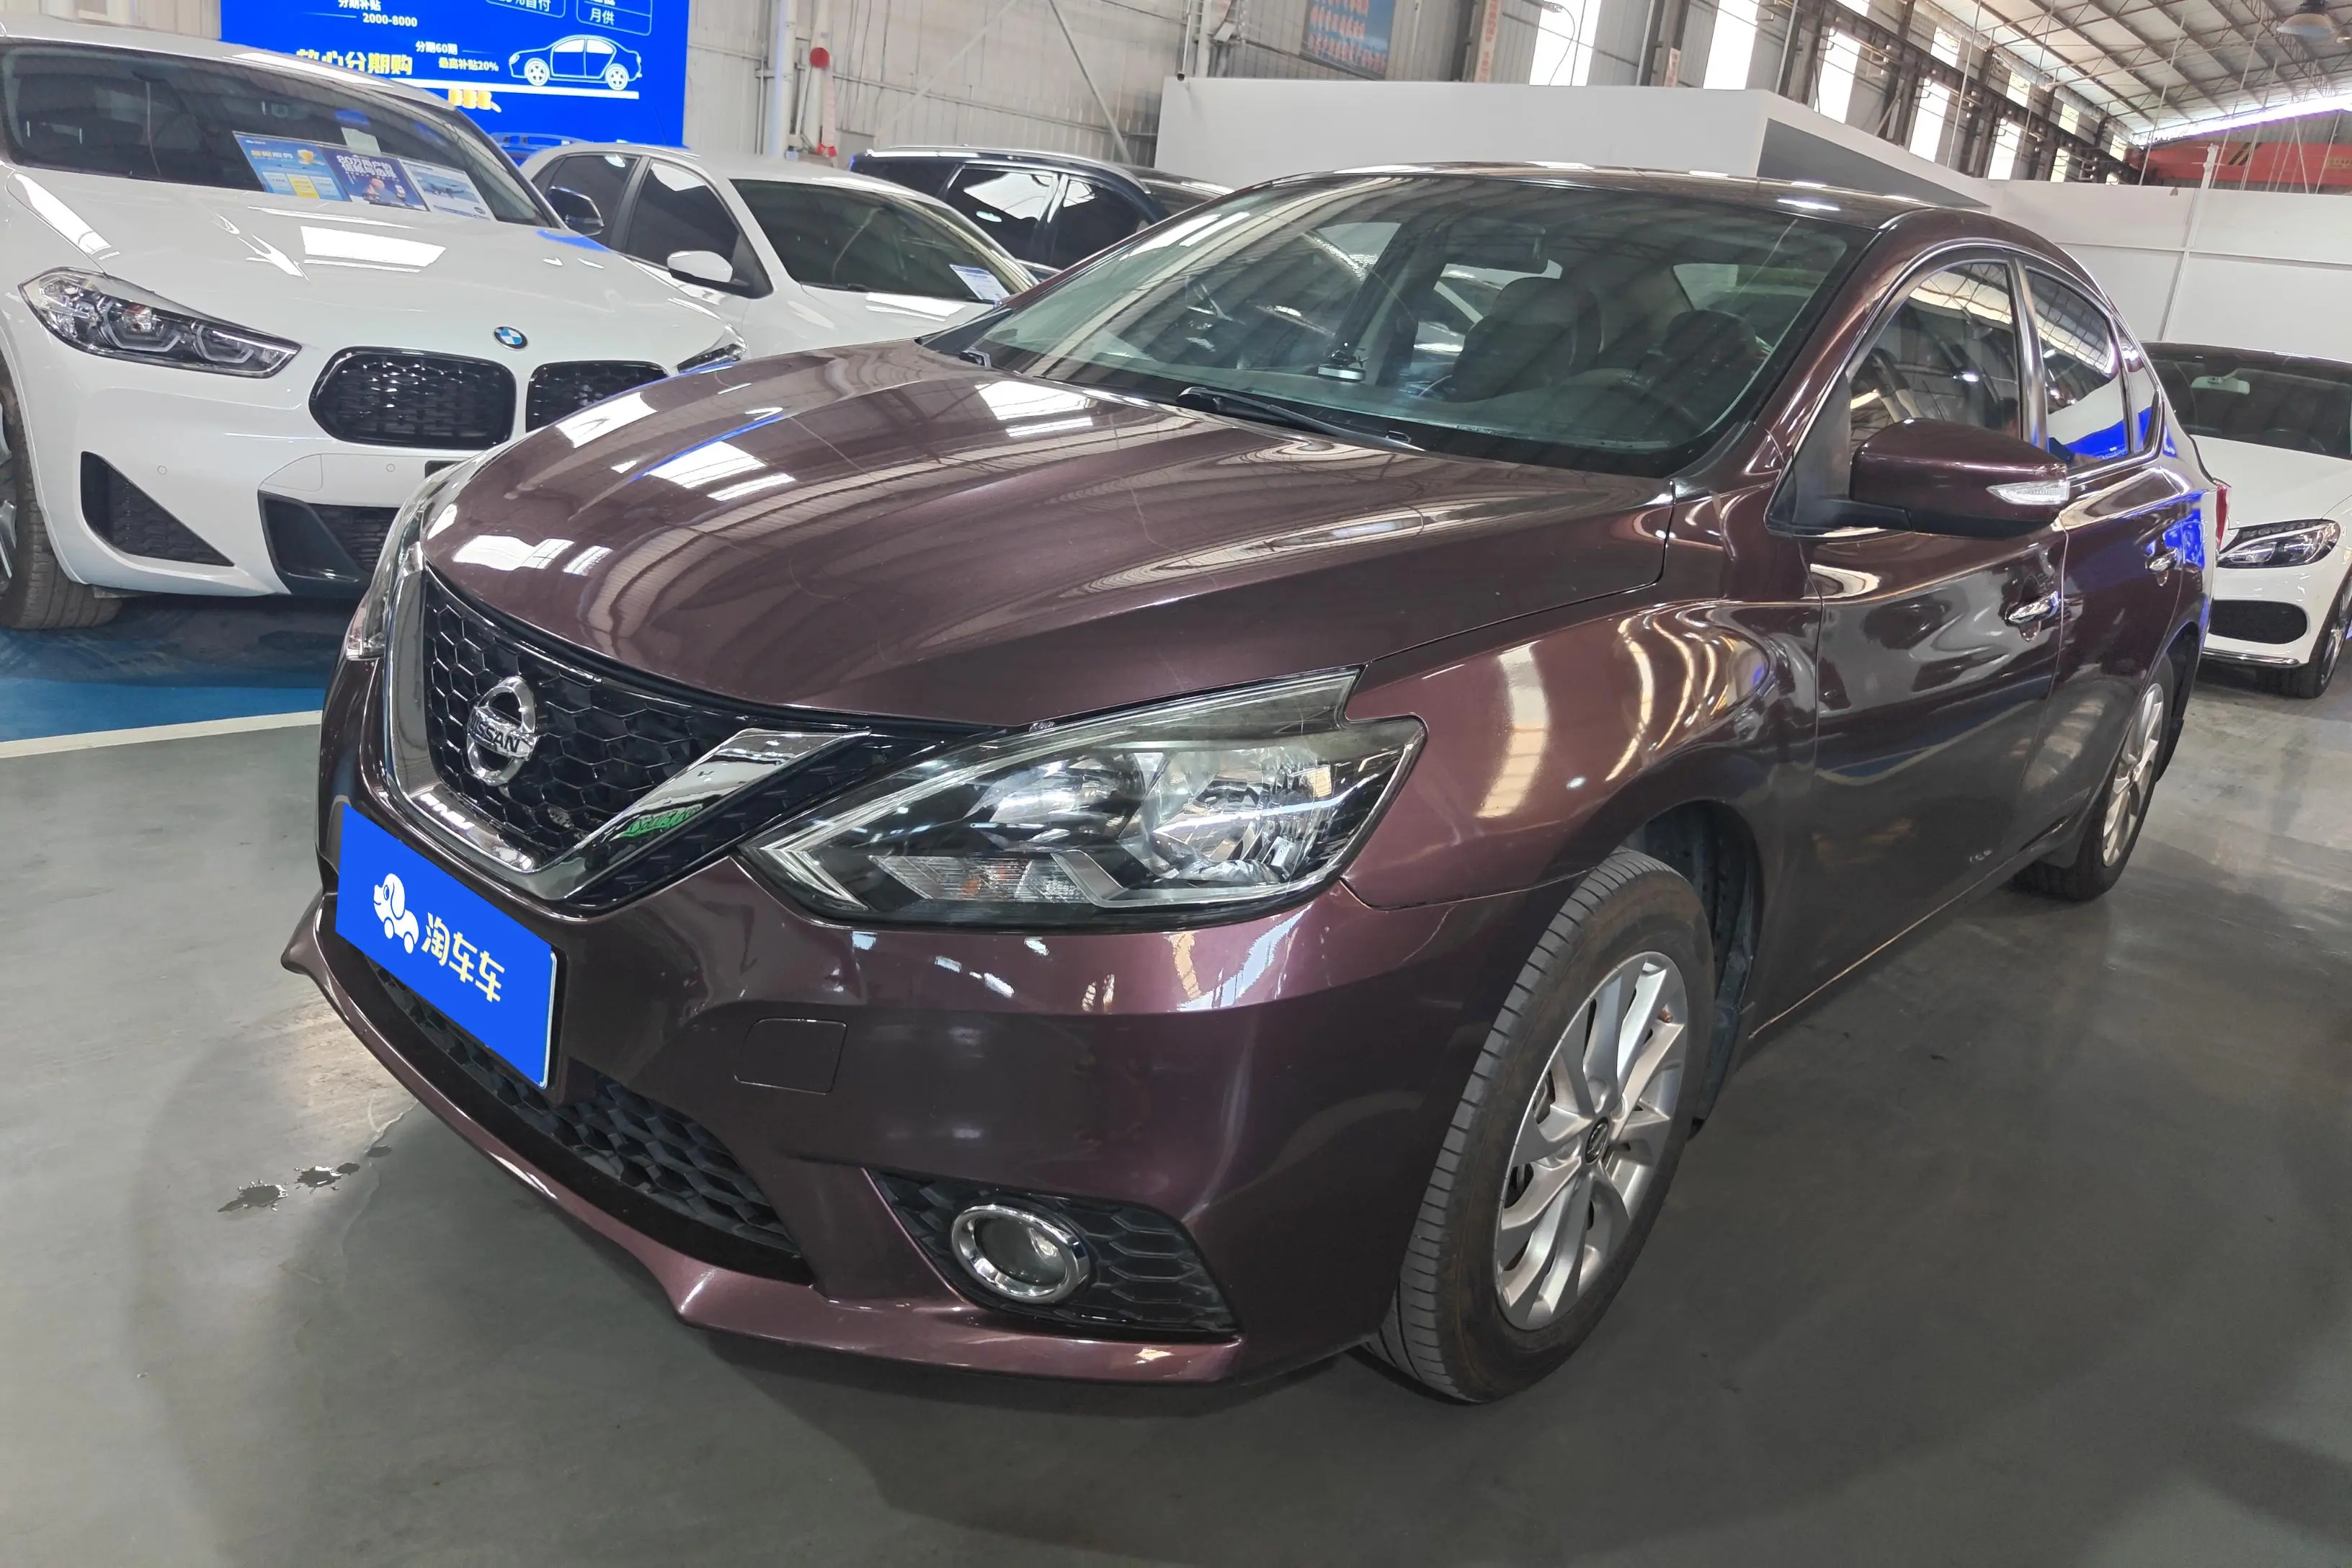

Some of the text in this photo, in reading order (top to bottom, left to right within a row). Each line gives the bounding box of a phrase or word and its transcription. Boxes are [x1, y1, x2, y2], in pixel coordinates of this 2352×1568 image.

[362, 12, 418, 27] 2000-8000
[589, 7, 615, 26] 月供
[415, 40, 458, 55] 分期60期
[438, 56, 499, 72] 最高补贴20%
[469, 711, 520, 753] NISSAN
